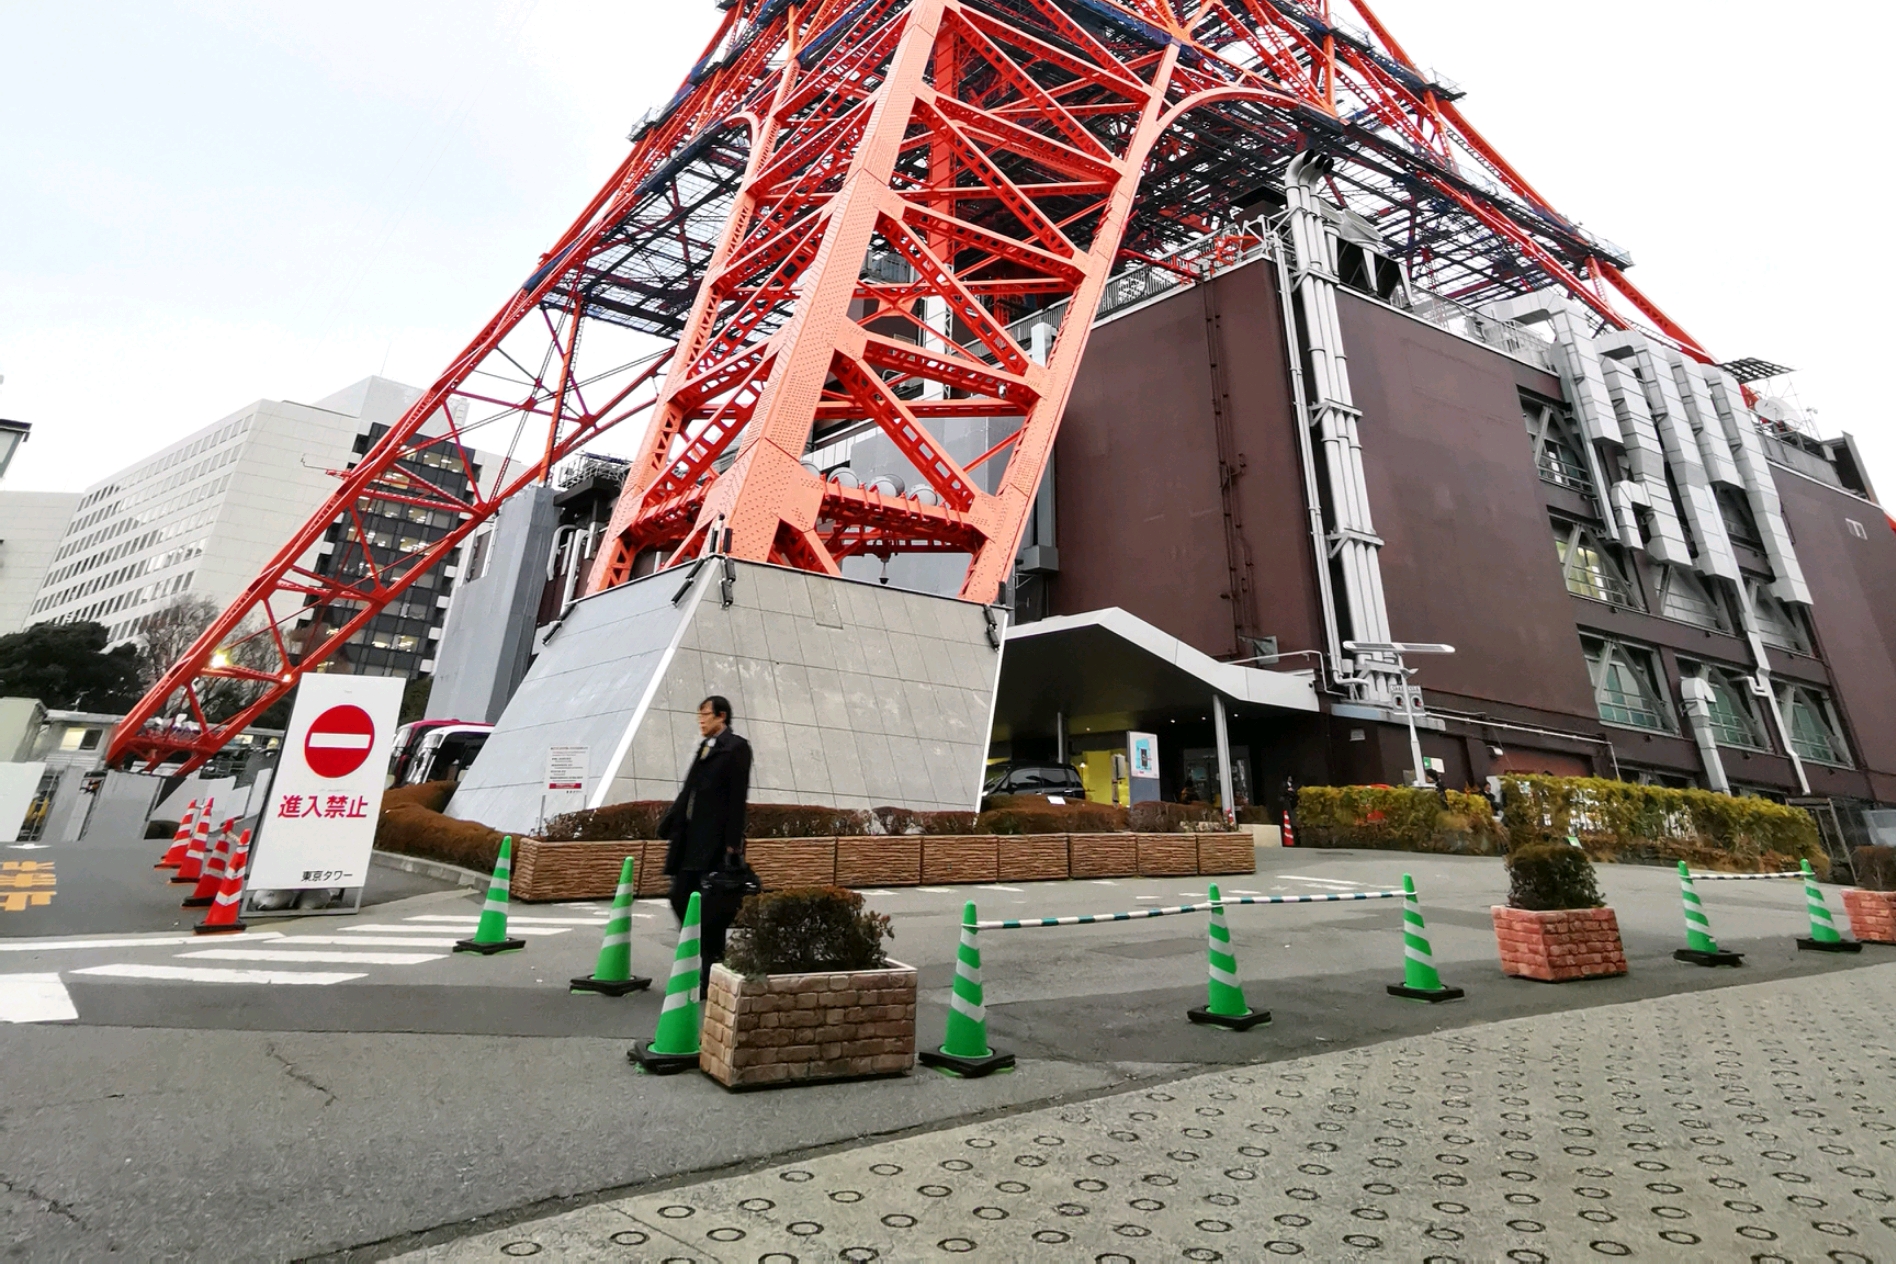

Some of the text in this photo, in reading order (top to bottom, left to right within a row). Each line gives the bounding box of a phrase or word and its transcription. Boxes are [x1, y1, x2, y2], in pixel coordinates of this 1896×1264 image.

[277, 794, 369, 819] 進入禁止
[301, 870, 353, 882] 東京タワー
